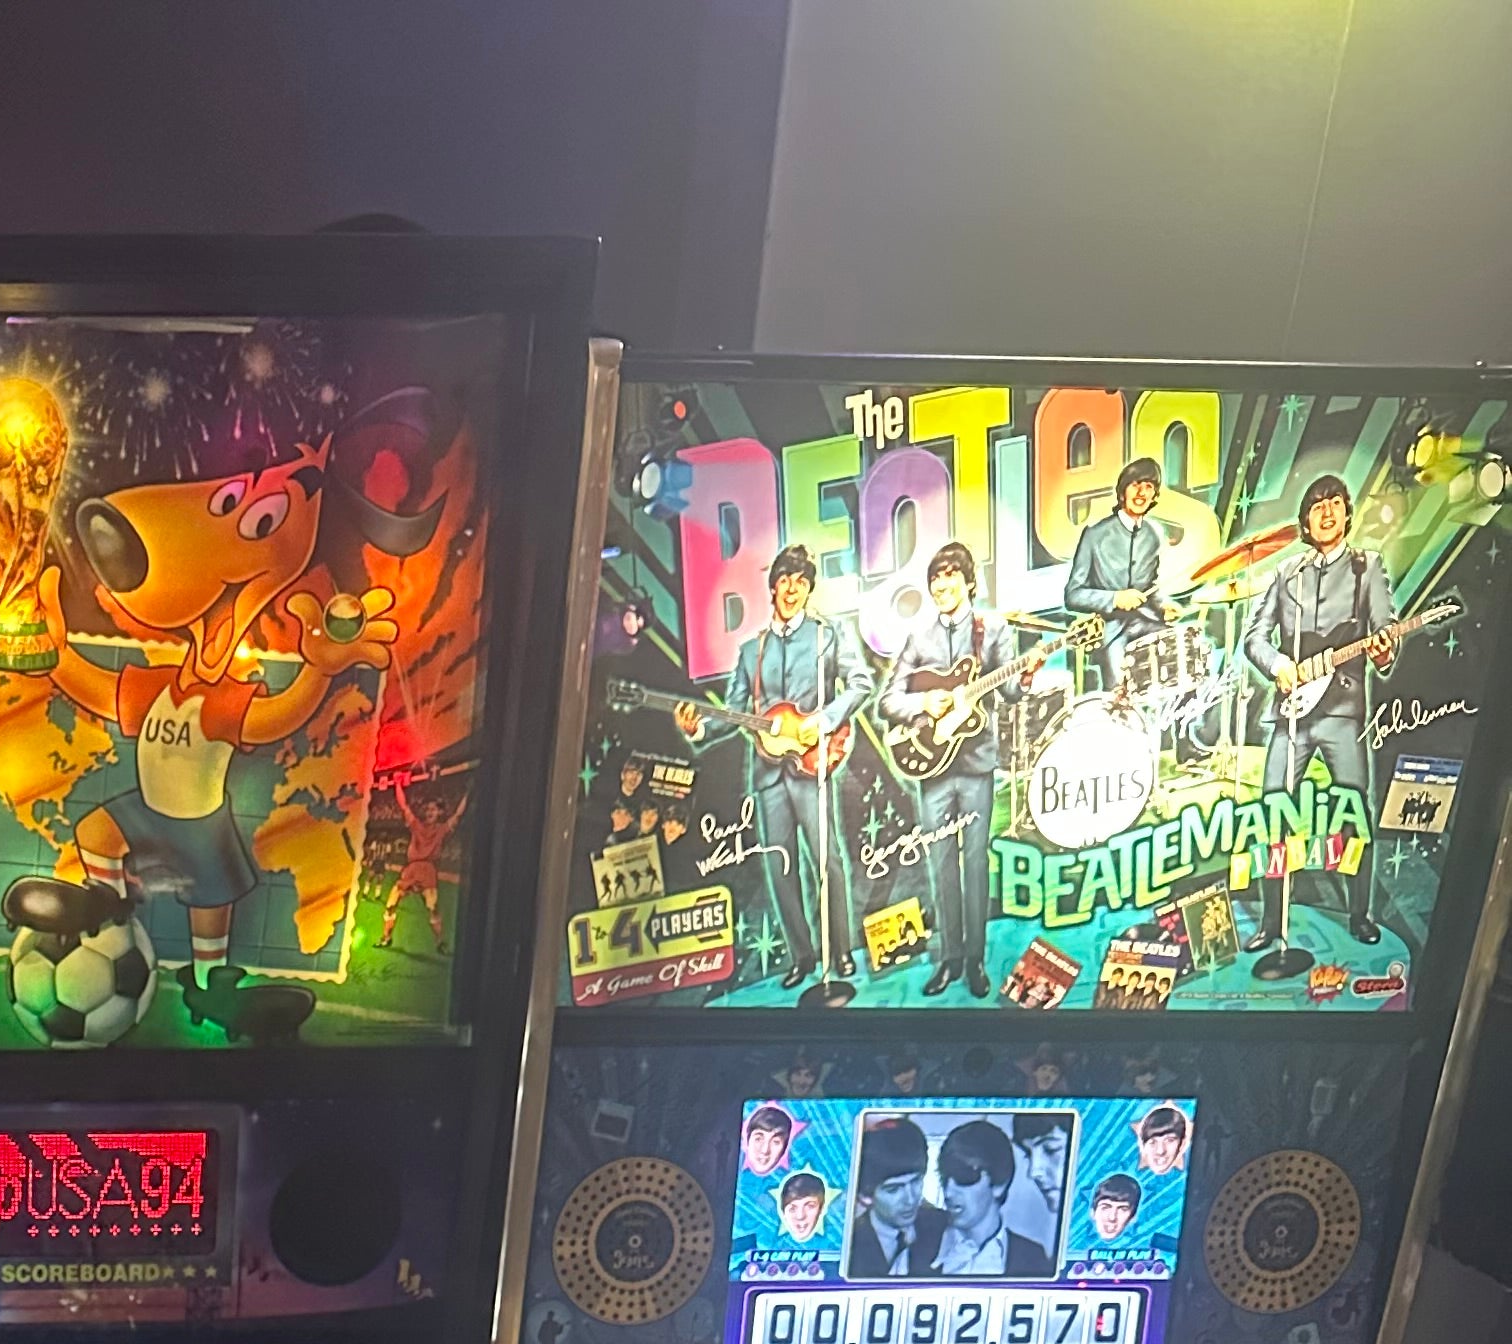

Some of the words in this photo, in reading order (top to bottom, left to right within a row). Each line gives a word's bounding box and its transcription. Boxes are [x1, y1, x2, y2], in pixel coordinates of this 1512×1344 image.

[846, 389, 906, 449] The
[145, 717, 192, 748] USA
[1040, 758, 1147, 815] BEATLES
[1231, 834, 1362, 889] PINBALL
[575, 917, 598, 967] 1
[592, 925, 608, 942] to
[608, 907, 644, 958] 4
[651, 904, 726, 938] PLAYERS
[1109, 939, 1132, 956] THE
[1132, 940, 1182, 958] BEATLES
[607, 973, 654, 996] Game
[658, 960, 687, 988] Of
[688, 952, 725, 977] Skill
[1, 1263, 160, 1284] SCOREBOARD
[1090, 1250, 1114, 1261] BALL
